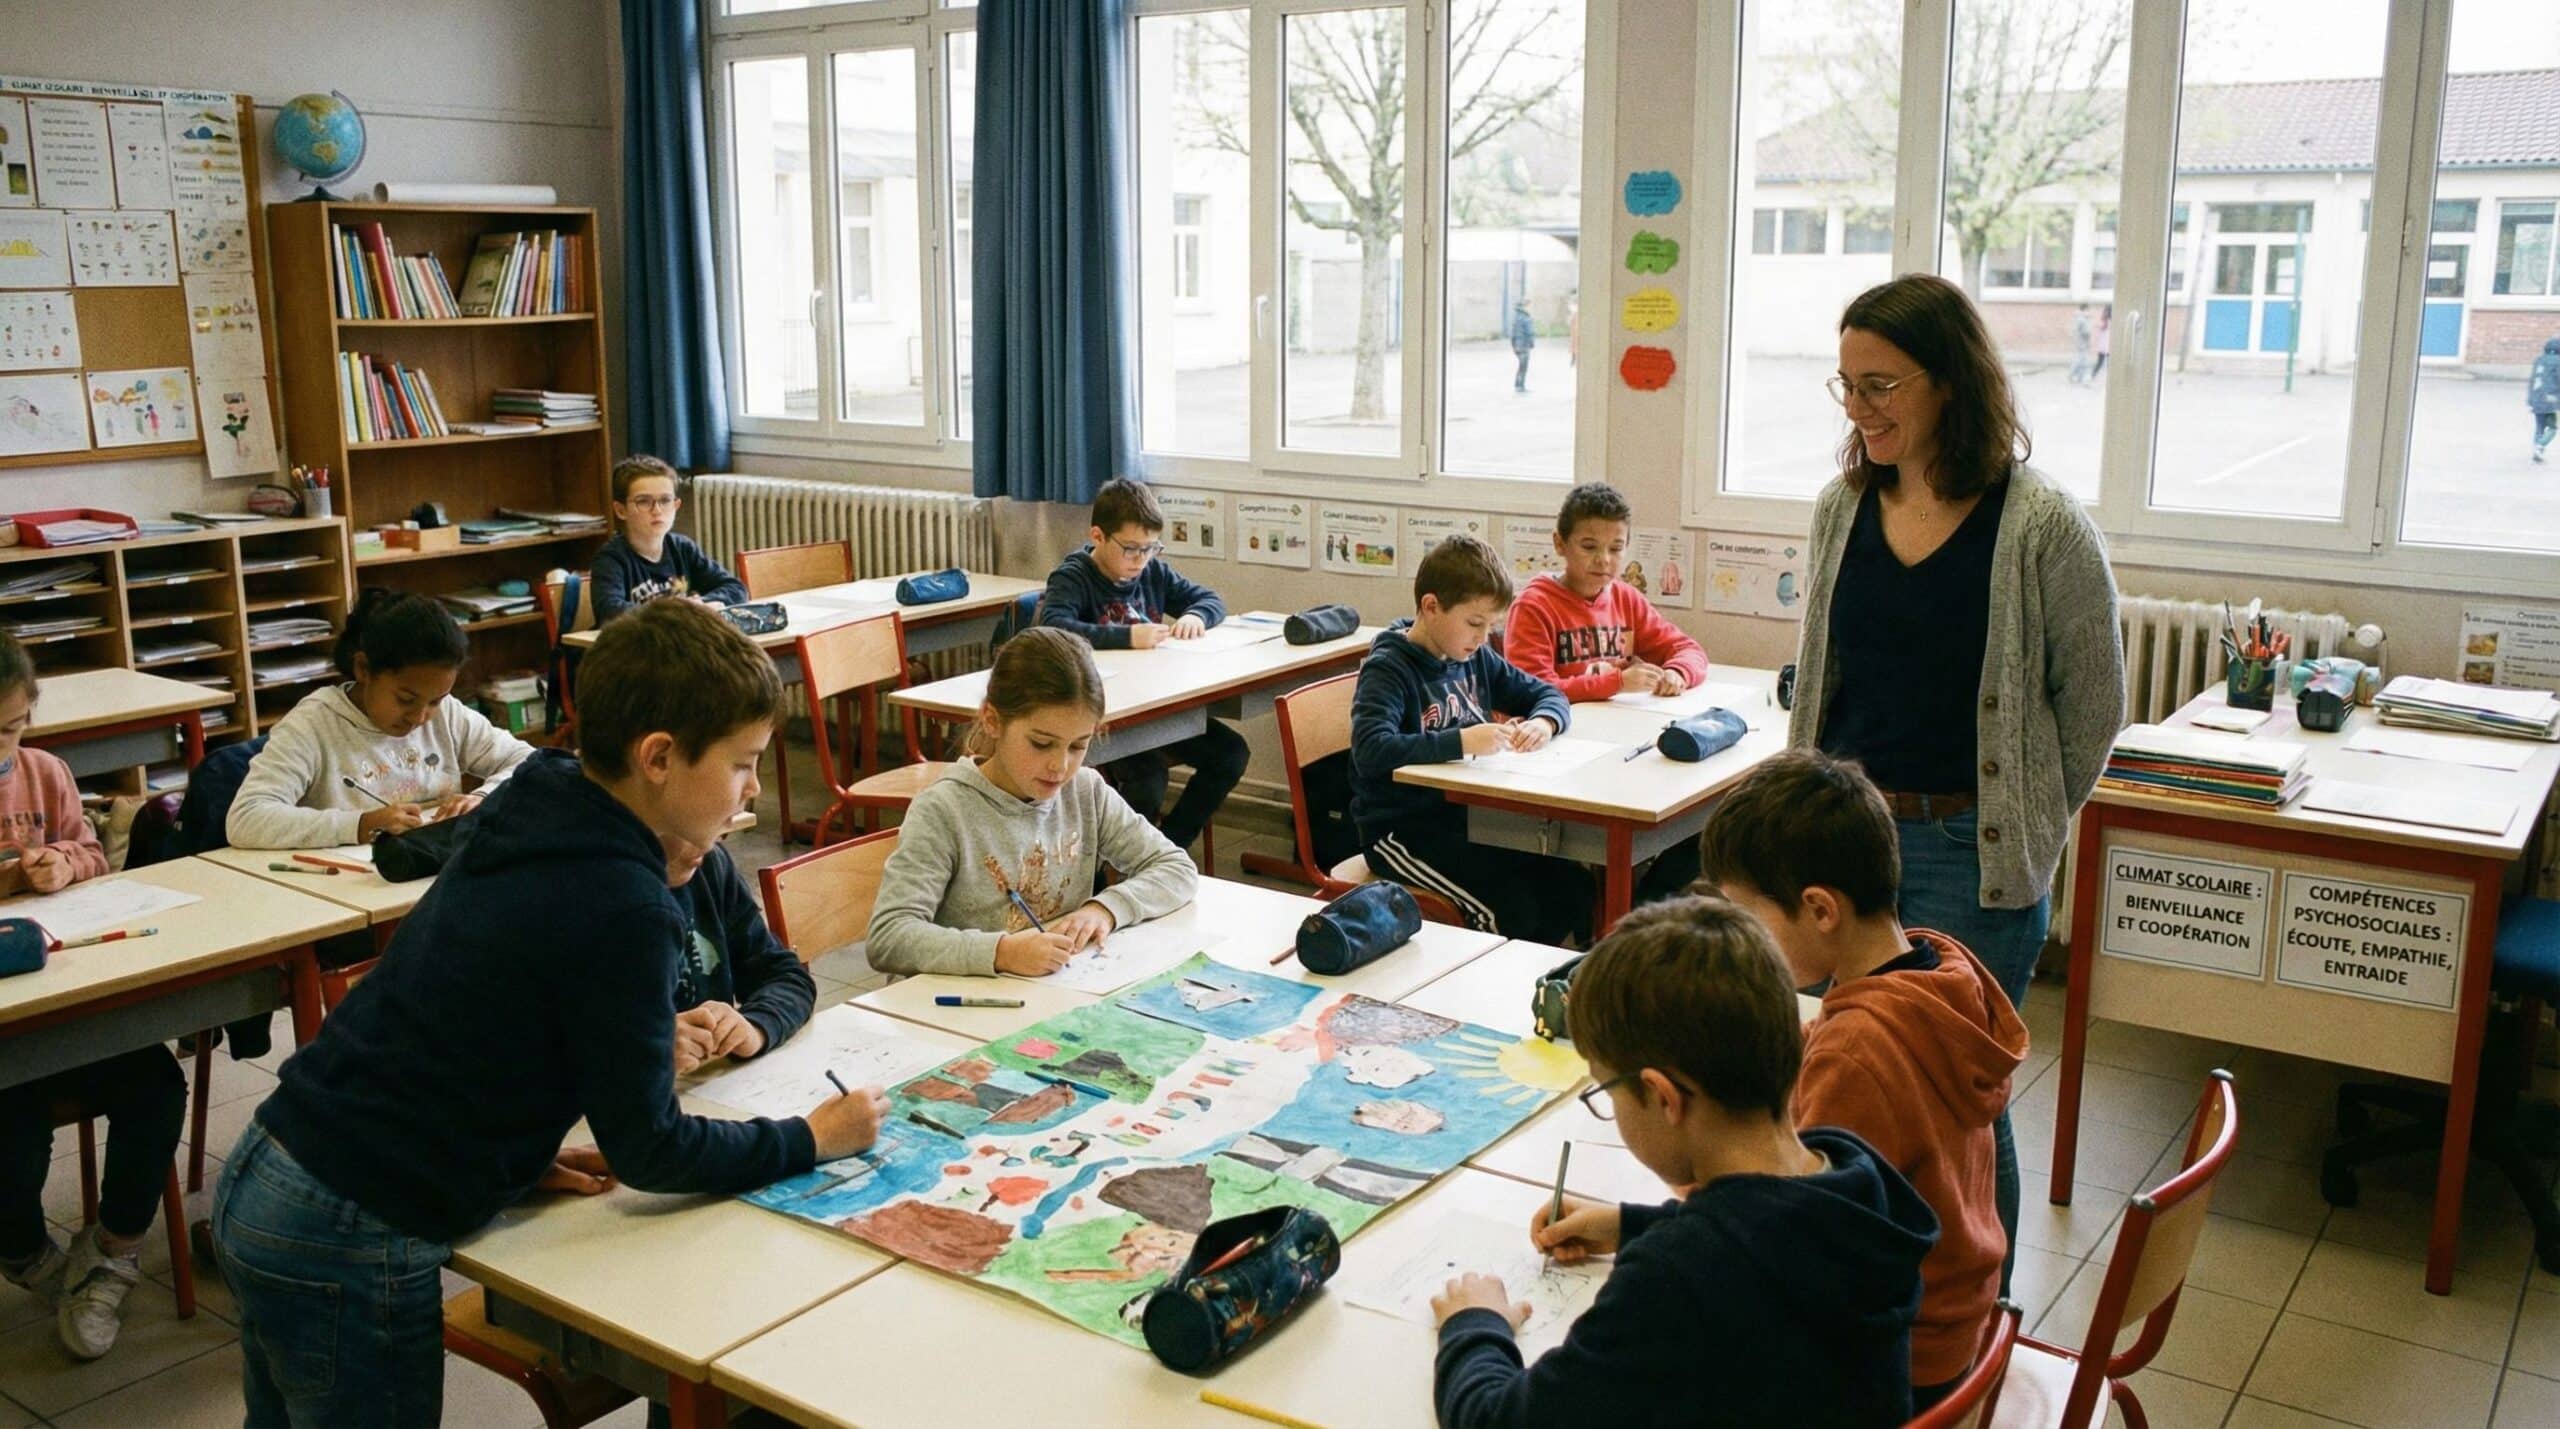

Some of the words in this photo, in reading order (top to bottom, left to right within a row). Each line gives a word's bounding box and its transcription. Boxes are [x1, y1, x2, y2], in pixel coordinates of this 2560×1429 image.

[2116, 864, 2173, 884] CLIMAT
[2176, 872, 2252, 896] SCOLAIRE
[2126, 894, 2244, 925] BIENVEILLANCE
[2309, 885, 2436, 916] COMPÉTENCES
[2117, 916, 2135, 931] ET
[2138, 918, 2250, 949] COOPÉRATION
[2294, 906, 2441, 941] PSYCHOSOCIALES
[2287, 929, 2356, 956] ÉCOUTE,
[2361, 942, 2453, 971] EMPATHIE,
[2324, 959, 2408, 986] ENTRAIDE
